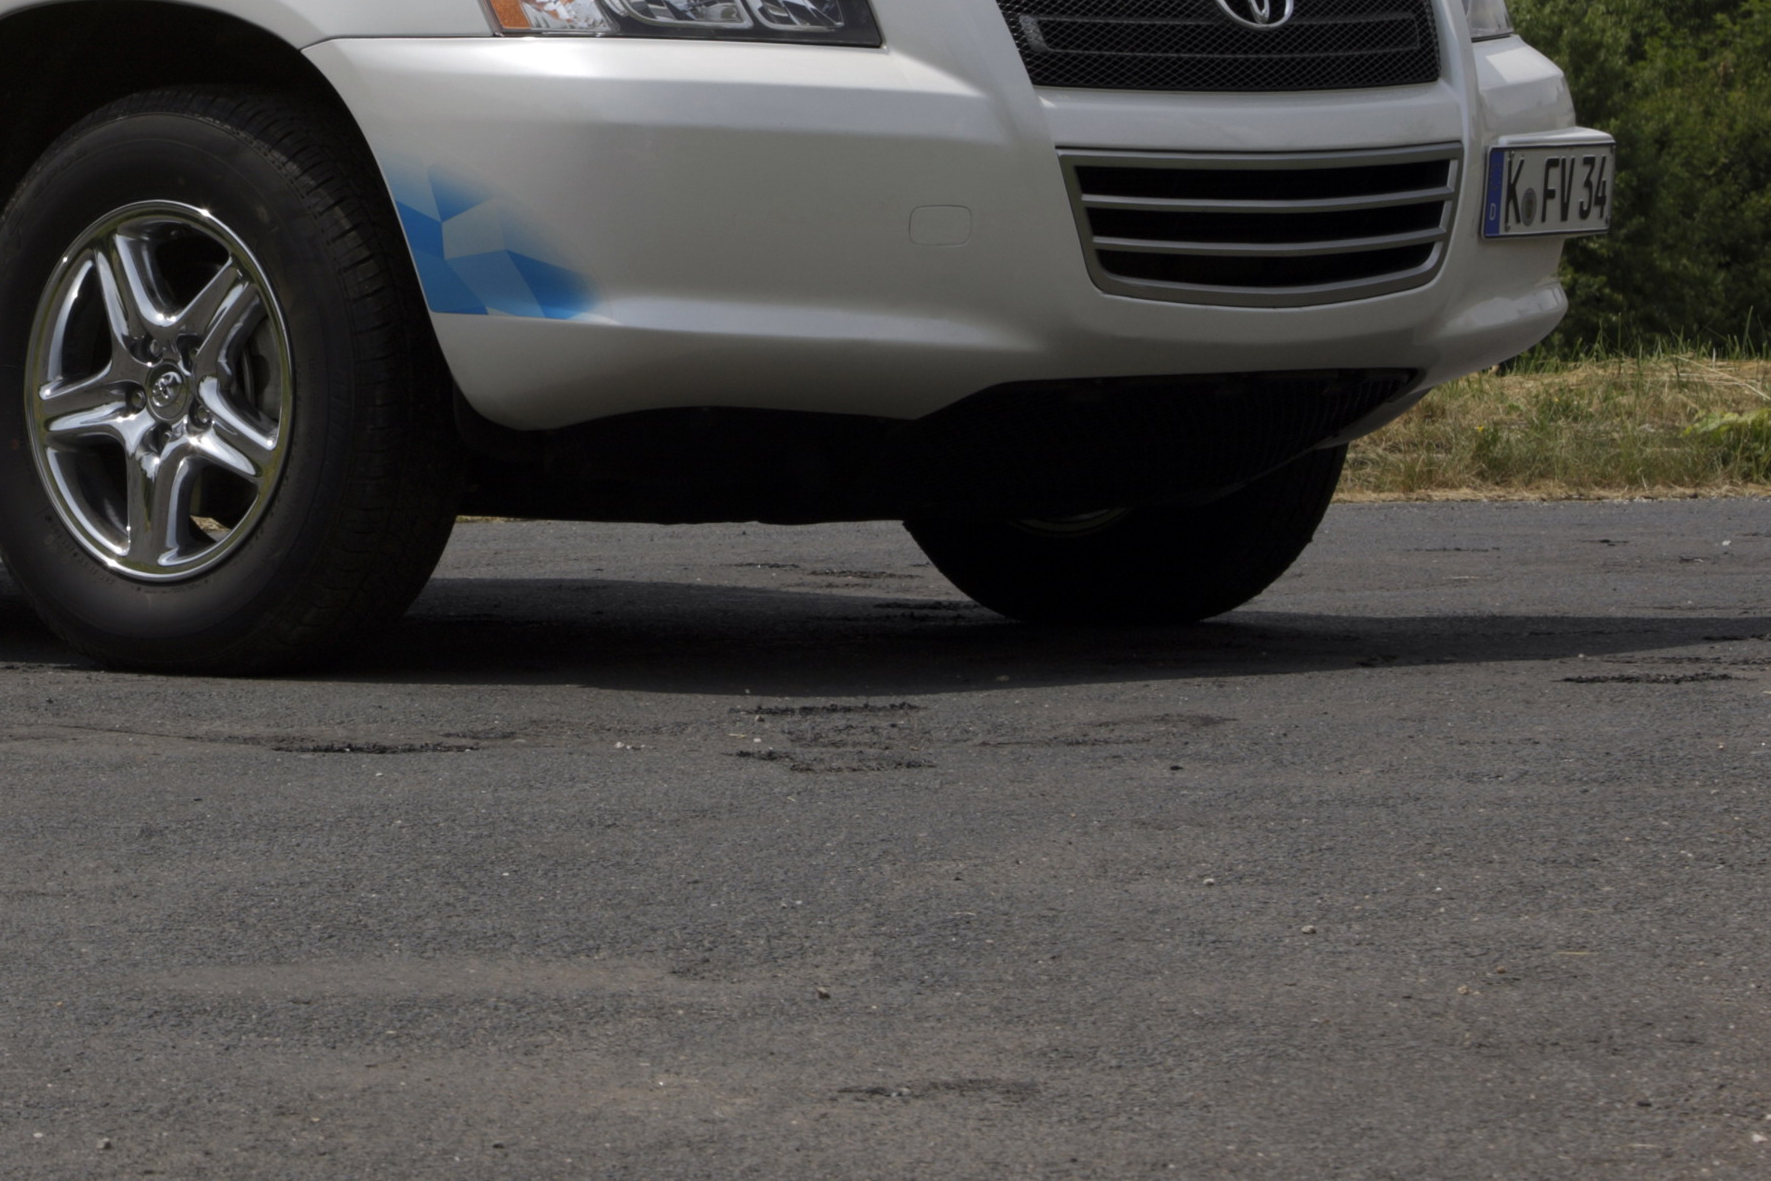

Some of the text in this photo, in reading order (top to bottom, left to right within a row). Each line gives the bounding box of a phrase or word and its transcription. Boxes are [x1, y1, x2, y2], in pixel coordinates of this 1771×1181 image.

[1504, 154, 1607, 227] K FV 34
